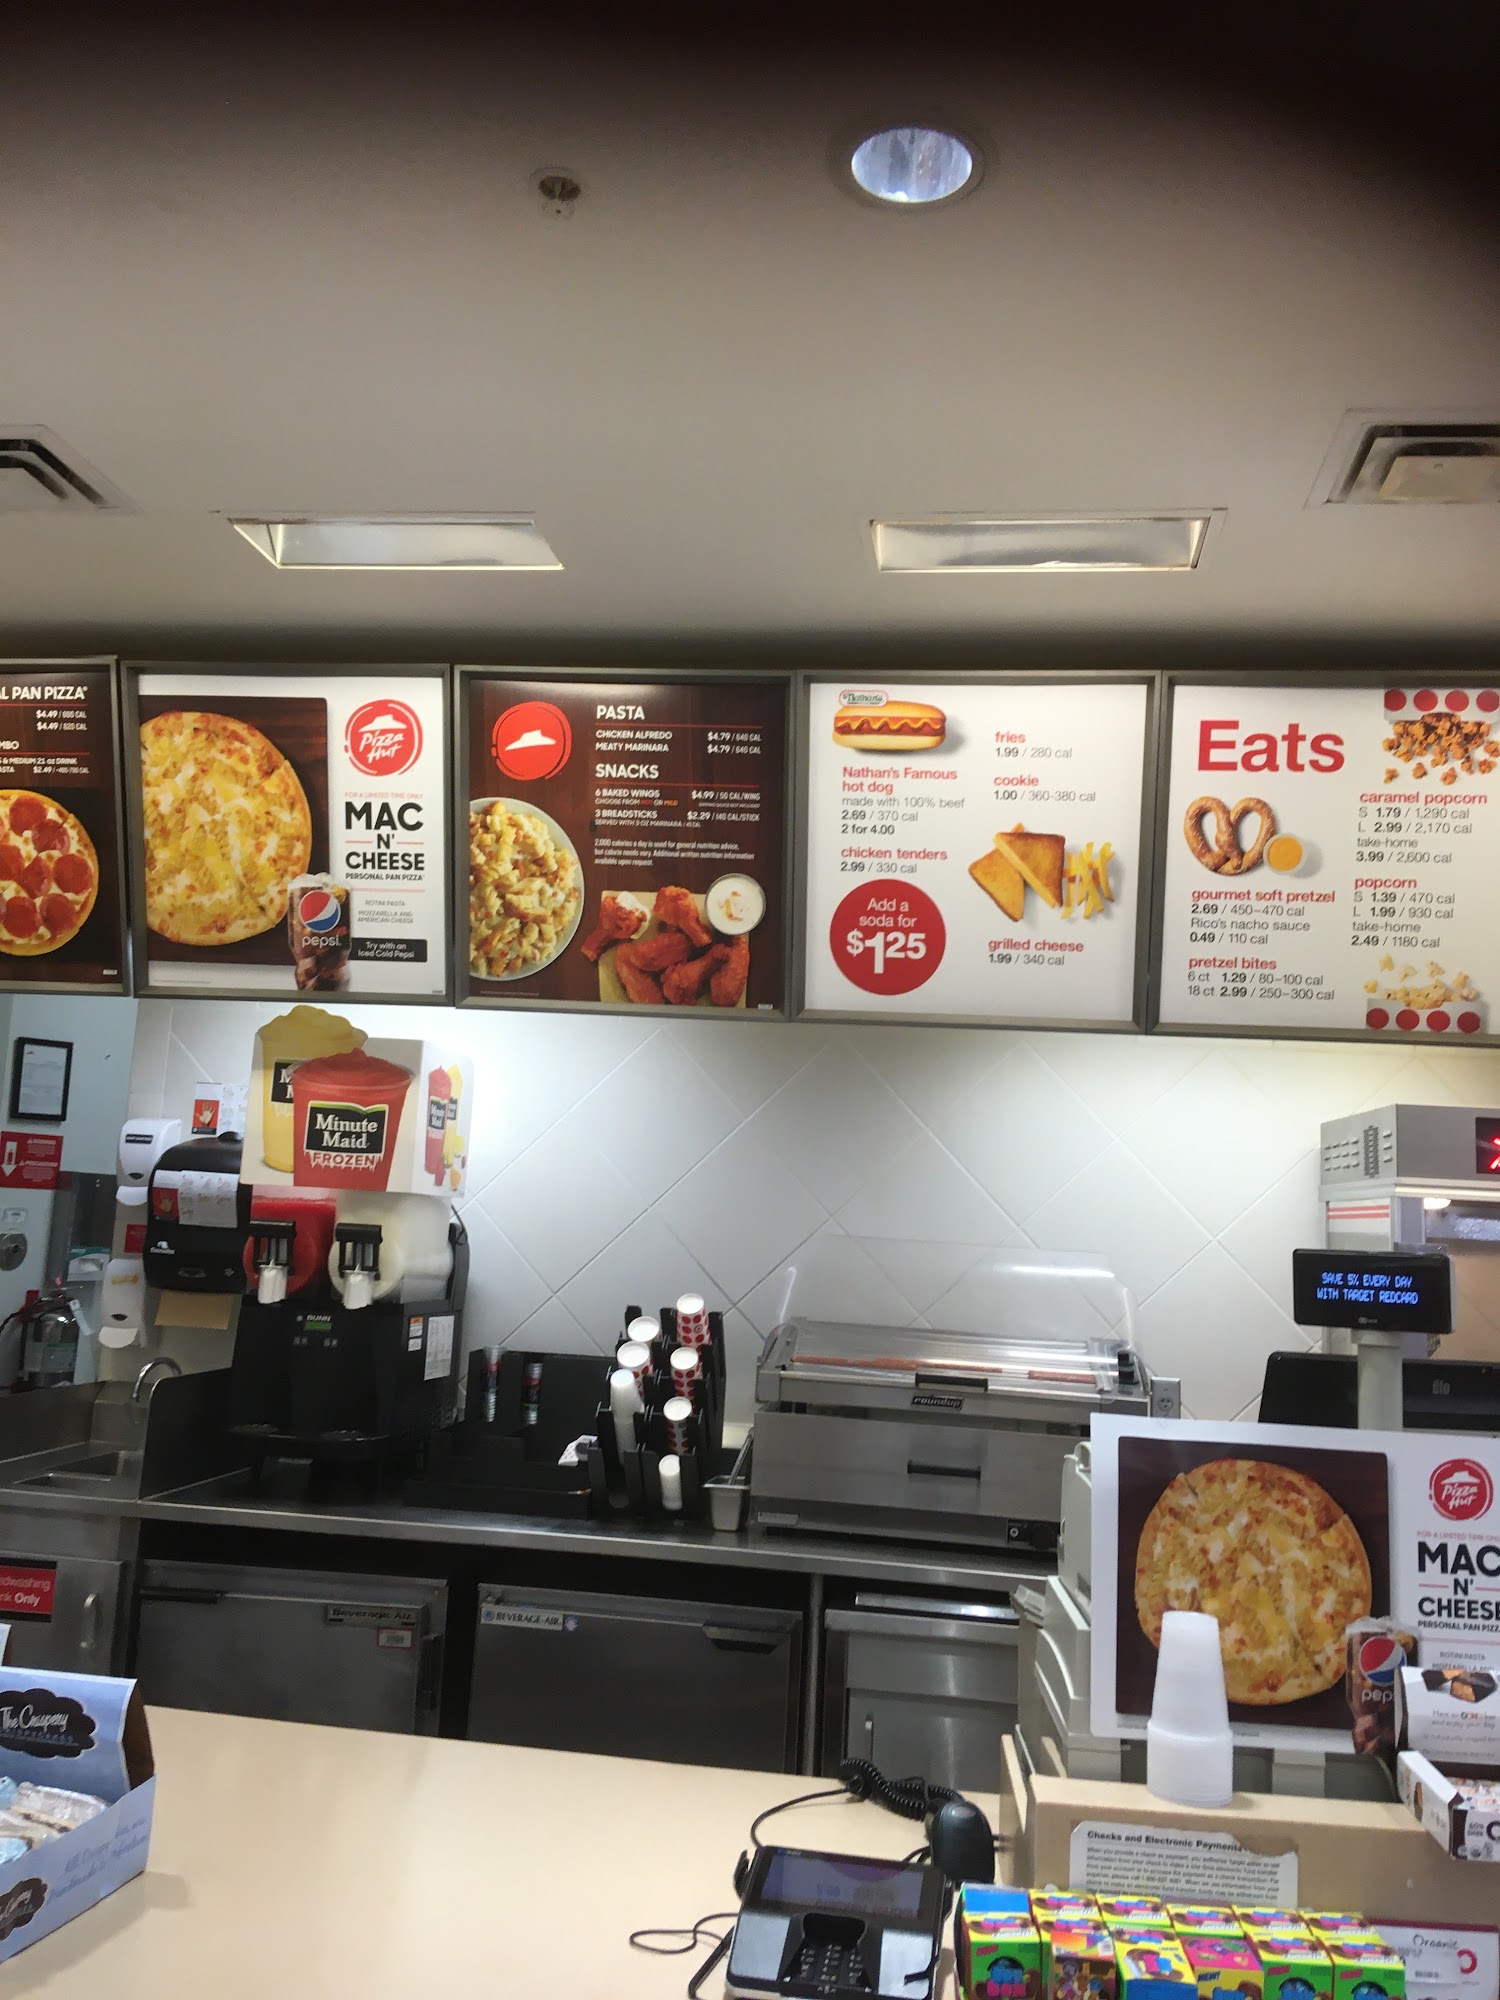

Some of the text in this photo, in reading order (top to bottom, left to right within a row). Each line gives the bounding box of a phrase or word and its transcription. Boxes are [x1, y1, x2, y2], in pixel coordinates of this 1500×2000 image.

[12, 686, 42, 700] PAN
[596, 704, 645, 720] PASTA
[595, 729, 762, 742] CHICKEN ALFREDO $4.79 CAL
[995, 731, 1026, 743] fries
[359, 730, 405, 764] Pizza Hut
[595, 742, 761, 755] MEATY MARINARA $4.79 CAL
[996, 746, 1073, 758] 1.99 280 cal
[1198, 720, 1345, 773] Eats
[595, 763, 660, 779] SNACKS
[842, 767, 958, 780] Nathan's Famous
[993, 774, 1040, 786] cookie
[595, 788, 601, 797] 6
[602, 788, 630, 798] BAKED
[631, 789, 660, 799] WINGS
[842, 781, 894, 795] hot dog
[842, 797, 966, 808] made with 100% beef
[994, 790, 1096, 802] 1.00 360-380 cal
[1359, 791, 1488, 807] caramel popcorn
[345, 801, 424, 831] MAC
[602, 809, 658, 819] BREADSTICKS
[687, 811, 711, 821] $2.29
[877, 811, 899, 821] 370
[901, 811, 919, 821] cal
[1358, 806, 1368, 818] S
[1376, 807, 1402, 818] 1.79
[1451, 808, 1470, 819] cal
[841, 824, 895, 835] 2 for 4.00
[1358, 821, 1473, 834] L 2.99 2,170 cal
[376, 833, 395, 849] N'
[1357, 837, 1419, 849] take-home
[841, 846, 948, 860] chicken tenders
[1356, 850, 1453, 864] 3.99 2,600 cal
[345, 851, 425, 871] CHEESE
[840, 861, 918, 874] 2.99 330 cal
[1354, 878, 1418, 891] popcorn
[1191, 889, 1336, 904] gourmet soft pretzel
[1353, 891, 1455, 905] S 1.39 470 cal
[866, 897, 909, 912] Add a
[1191, 903, 1219, 914] 2.69
[1286, 906, 1305, 917] cal
[1352, 905, 1454, 919] L 1.99 930 cal
[859, 913, 918, 928] soda for
[1190, 917, 1311, 931] Rico's nacho sauce
[1352, 920, 1421, 933] take-home
[302, 934, 340, 948] pepsi
[988, 938, 1085, 952] grilled cheese
[1189, 931, 1269, 945] 0.49 110 cal
[1351, 934, 1441, 948] 2.49 1180 cal
[366, 942, 378, 950] Try
[379, 942, 396, 950] with
[358, 949, 415, 959] Iced Cold Pepsi
[988, 953, 1065, 966] 1.99 340 cal
[1188, 956, 1277, 970] pretzel bites
[1187, 971, 1195, 983] 6
[1198, 972, 1210, 982] ct
[1221, 972, 1247, 983] 1.29
[1305, 974, 1324, 985] cal
[1188, 984, 1201, 996] 18
[1203, 985, 1215, 997] ct
[1220, 986, 1248, 998] 2.99
[1316, 989, 1335, 1000] cal
[315, 1113, 379, 1133] Minute
[322, 1133, 371, 1149] Maid
[313, 1152, 375, 1167] FROZEN
[1321, 1272, 1413, 1288] SAVE 5% EVERY DAY
[1316, 1287, 1419, 1305] WITH TARGET REDCARD
[1441, 1483, 1479, 1510] Pizza Hut
[1418, 1541, 1500, 1577] MAC
[1453, 1578, 1474, 1596] N'
[15, 1592, 40, 1607] Only
[1418, 1620, 1481, 1631] PERSONAL PAN
[0, 1706, 19, 1730] The
[1087, 1830, 1122, 1841] Checks
[1125, 1834, 1143, 1843] and
[1145, 1835, 1193, 1848] Electronic
